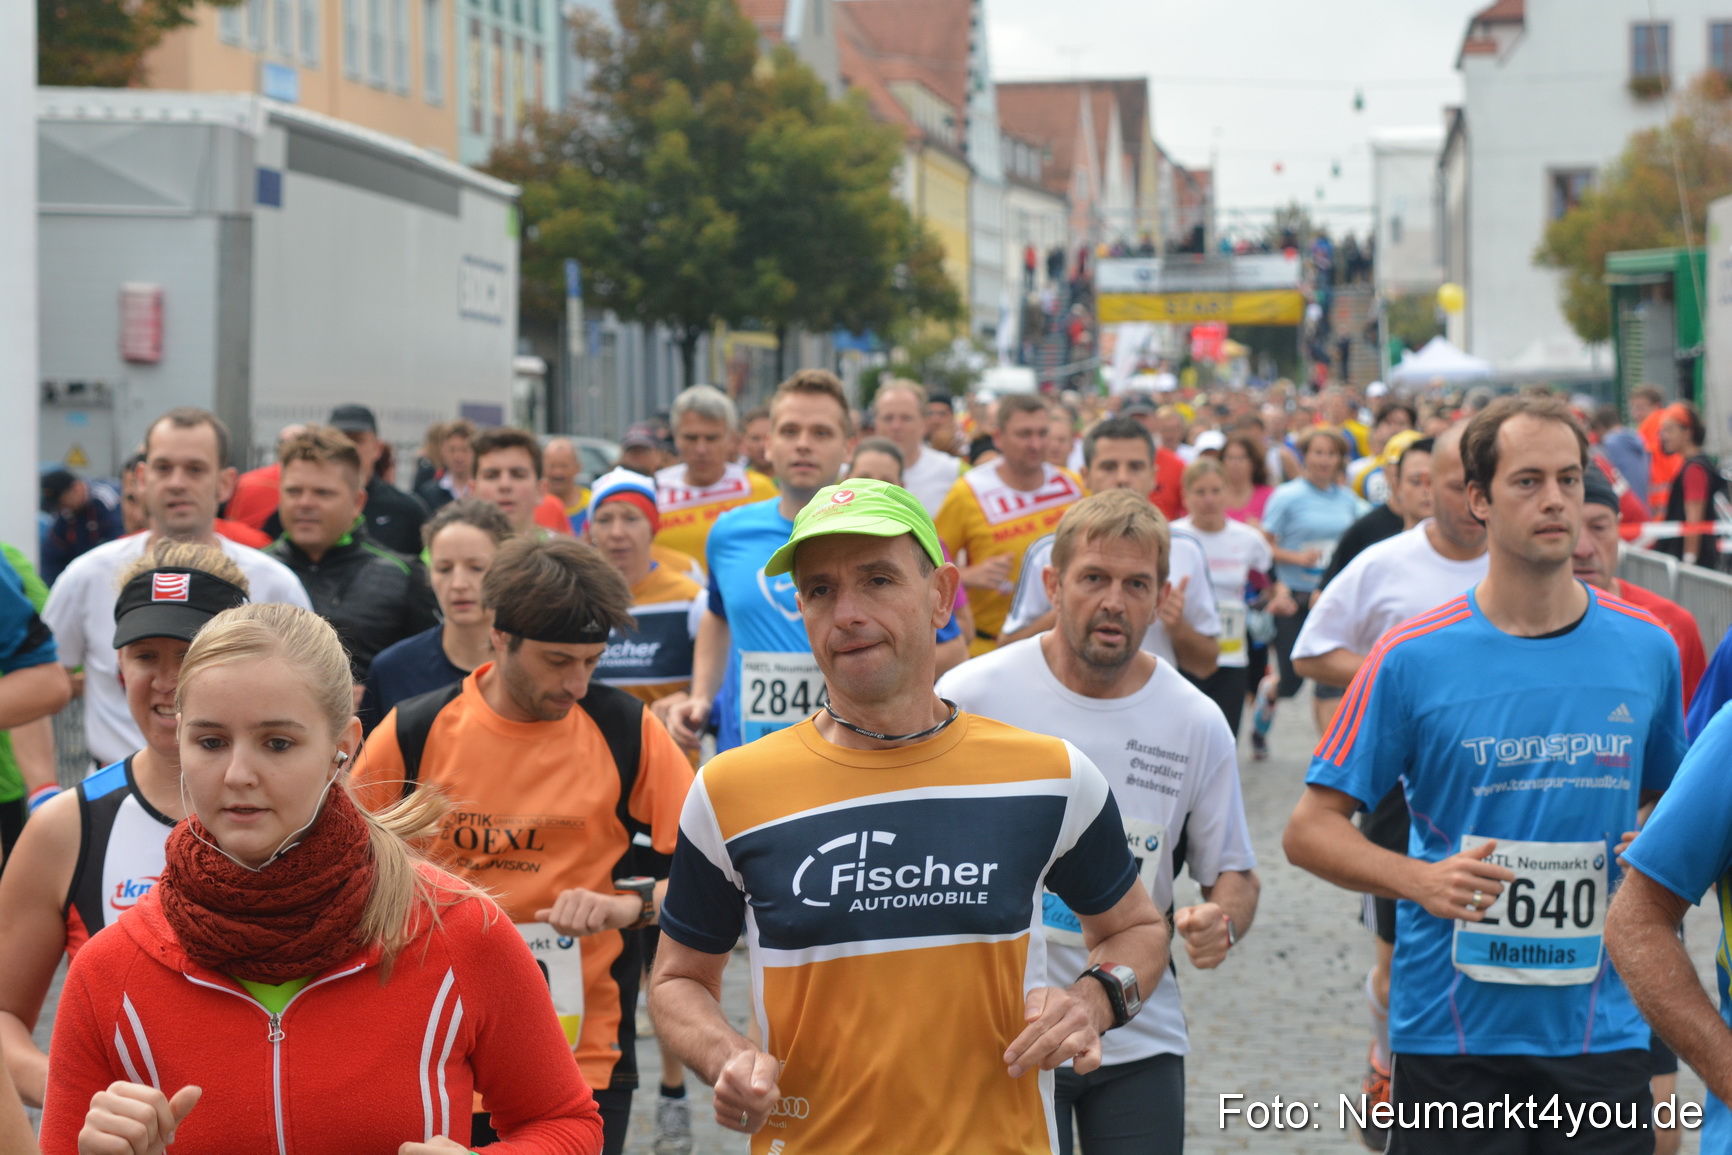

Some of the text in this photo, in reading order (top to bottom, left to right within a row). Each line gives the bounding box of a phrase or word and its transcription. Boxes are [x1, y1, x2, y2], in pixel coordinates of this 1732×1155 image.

[1461, 733, 1633, 765] Tonspur
[453, 826, 545, 855] OEXL
[830, 855, 999, 896] Fischer
[1518, 857, 1588, 871] Neumarkt
[848, 891, 989, 913] AUTOMOBILE
[1489, 941, 1577, 964] Matthias
[768, 1119, 787, 1129] Audi
